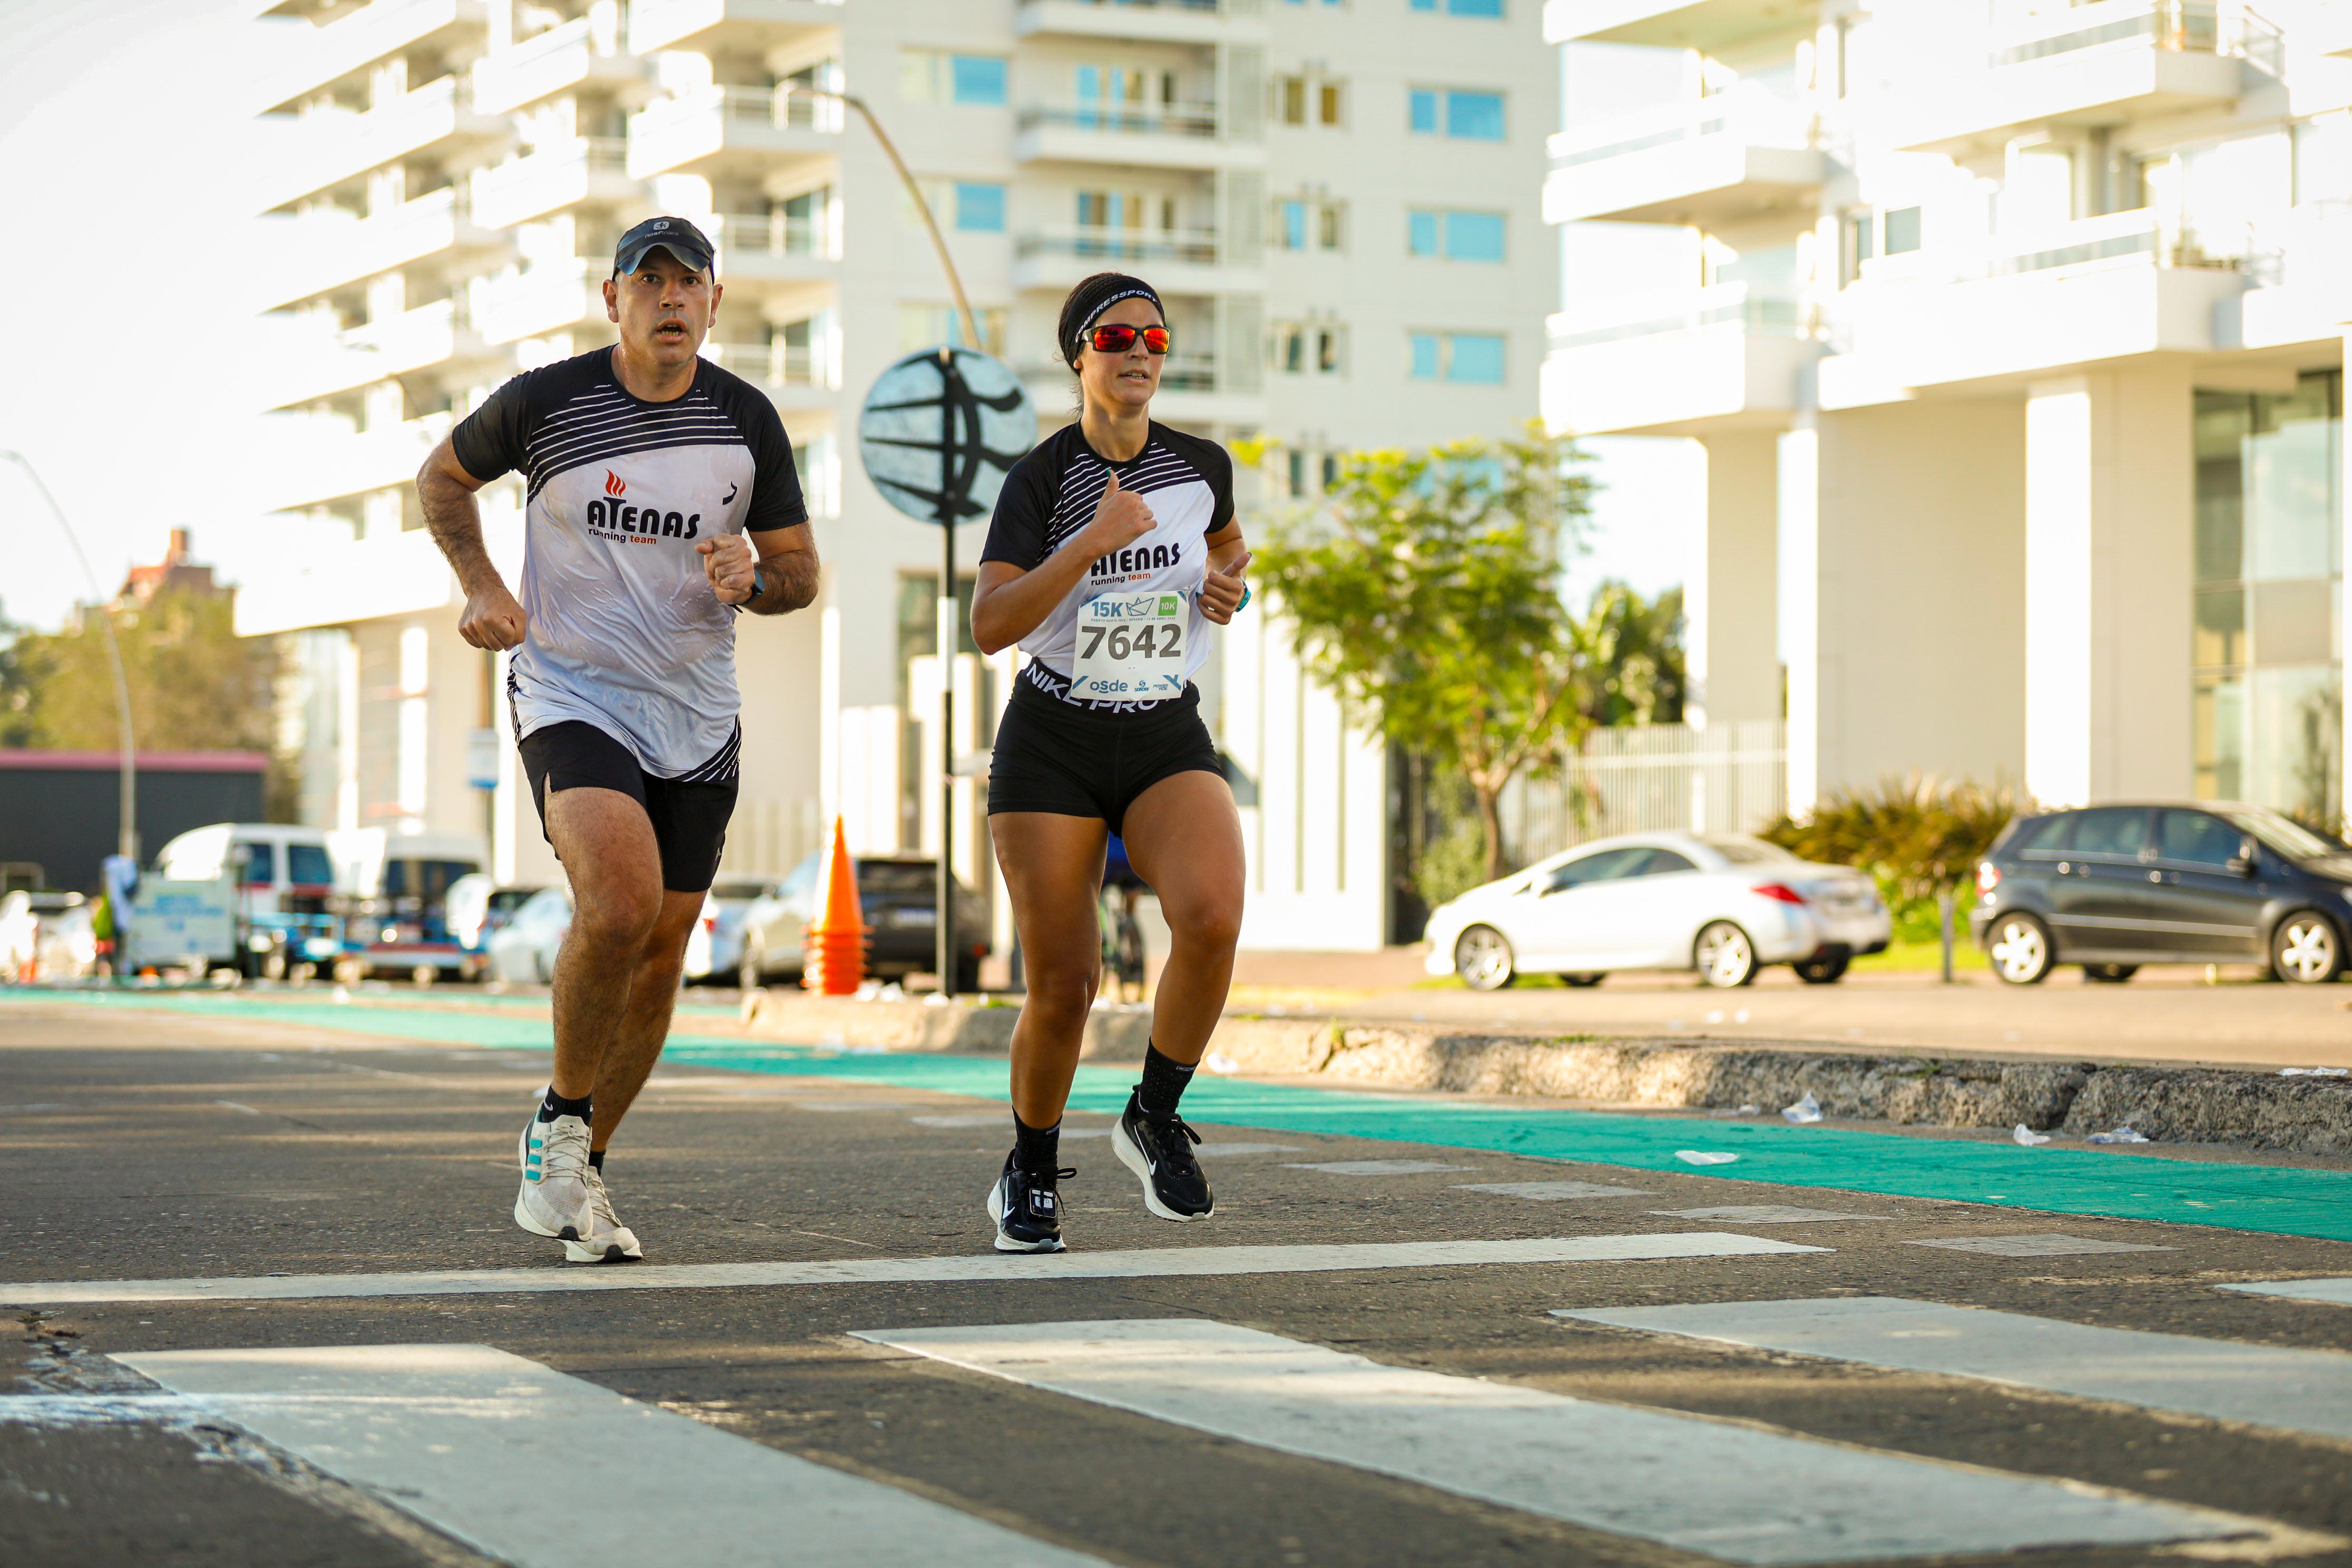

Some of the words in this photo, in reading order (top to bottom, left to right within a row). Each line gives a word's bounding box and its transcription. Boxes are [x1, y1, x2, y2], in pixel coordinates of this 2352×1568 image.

[1075, 290, 1157, 342] COMPRESSPORT
[587, 496, 700, 539] ATENAS
[589, 527, 626, 543] running
[630, 535, 656, 544] team
[1091, 576, 1125, 586] running
[1092, 601, 1123, 617] 15K
[1161, 602, 1175, 610] 10K
[1081, 624, 1181, 660] 7642
[1090, 679, 1128, 693] osde
